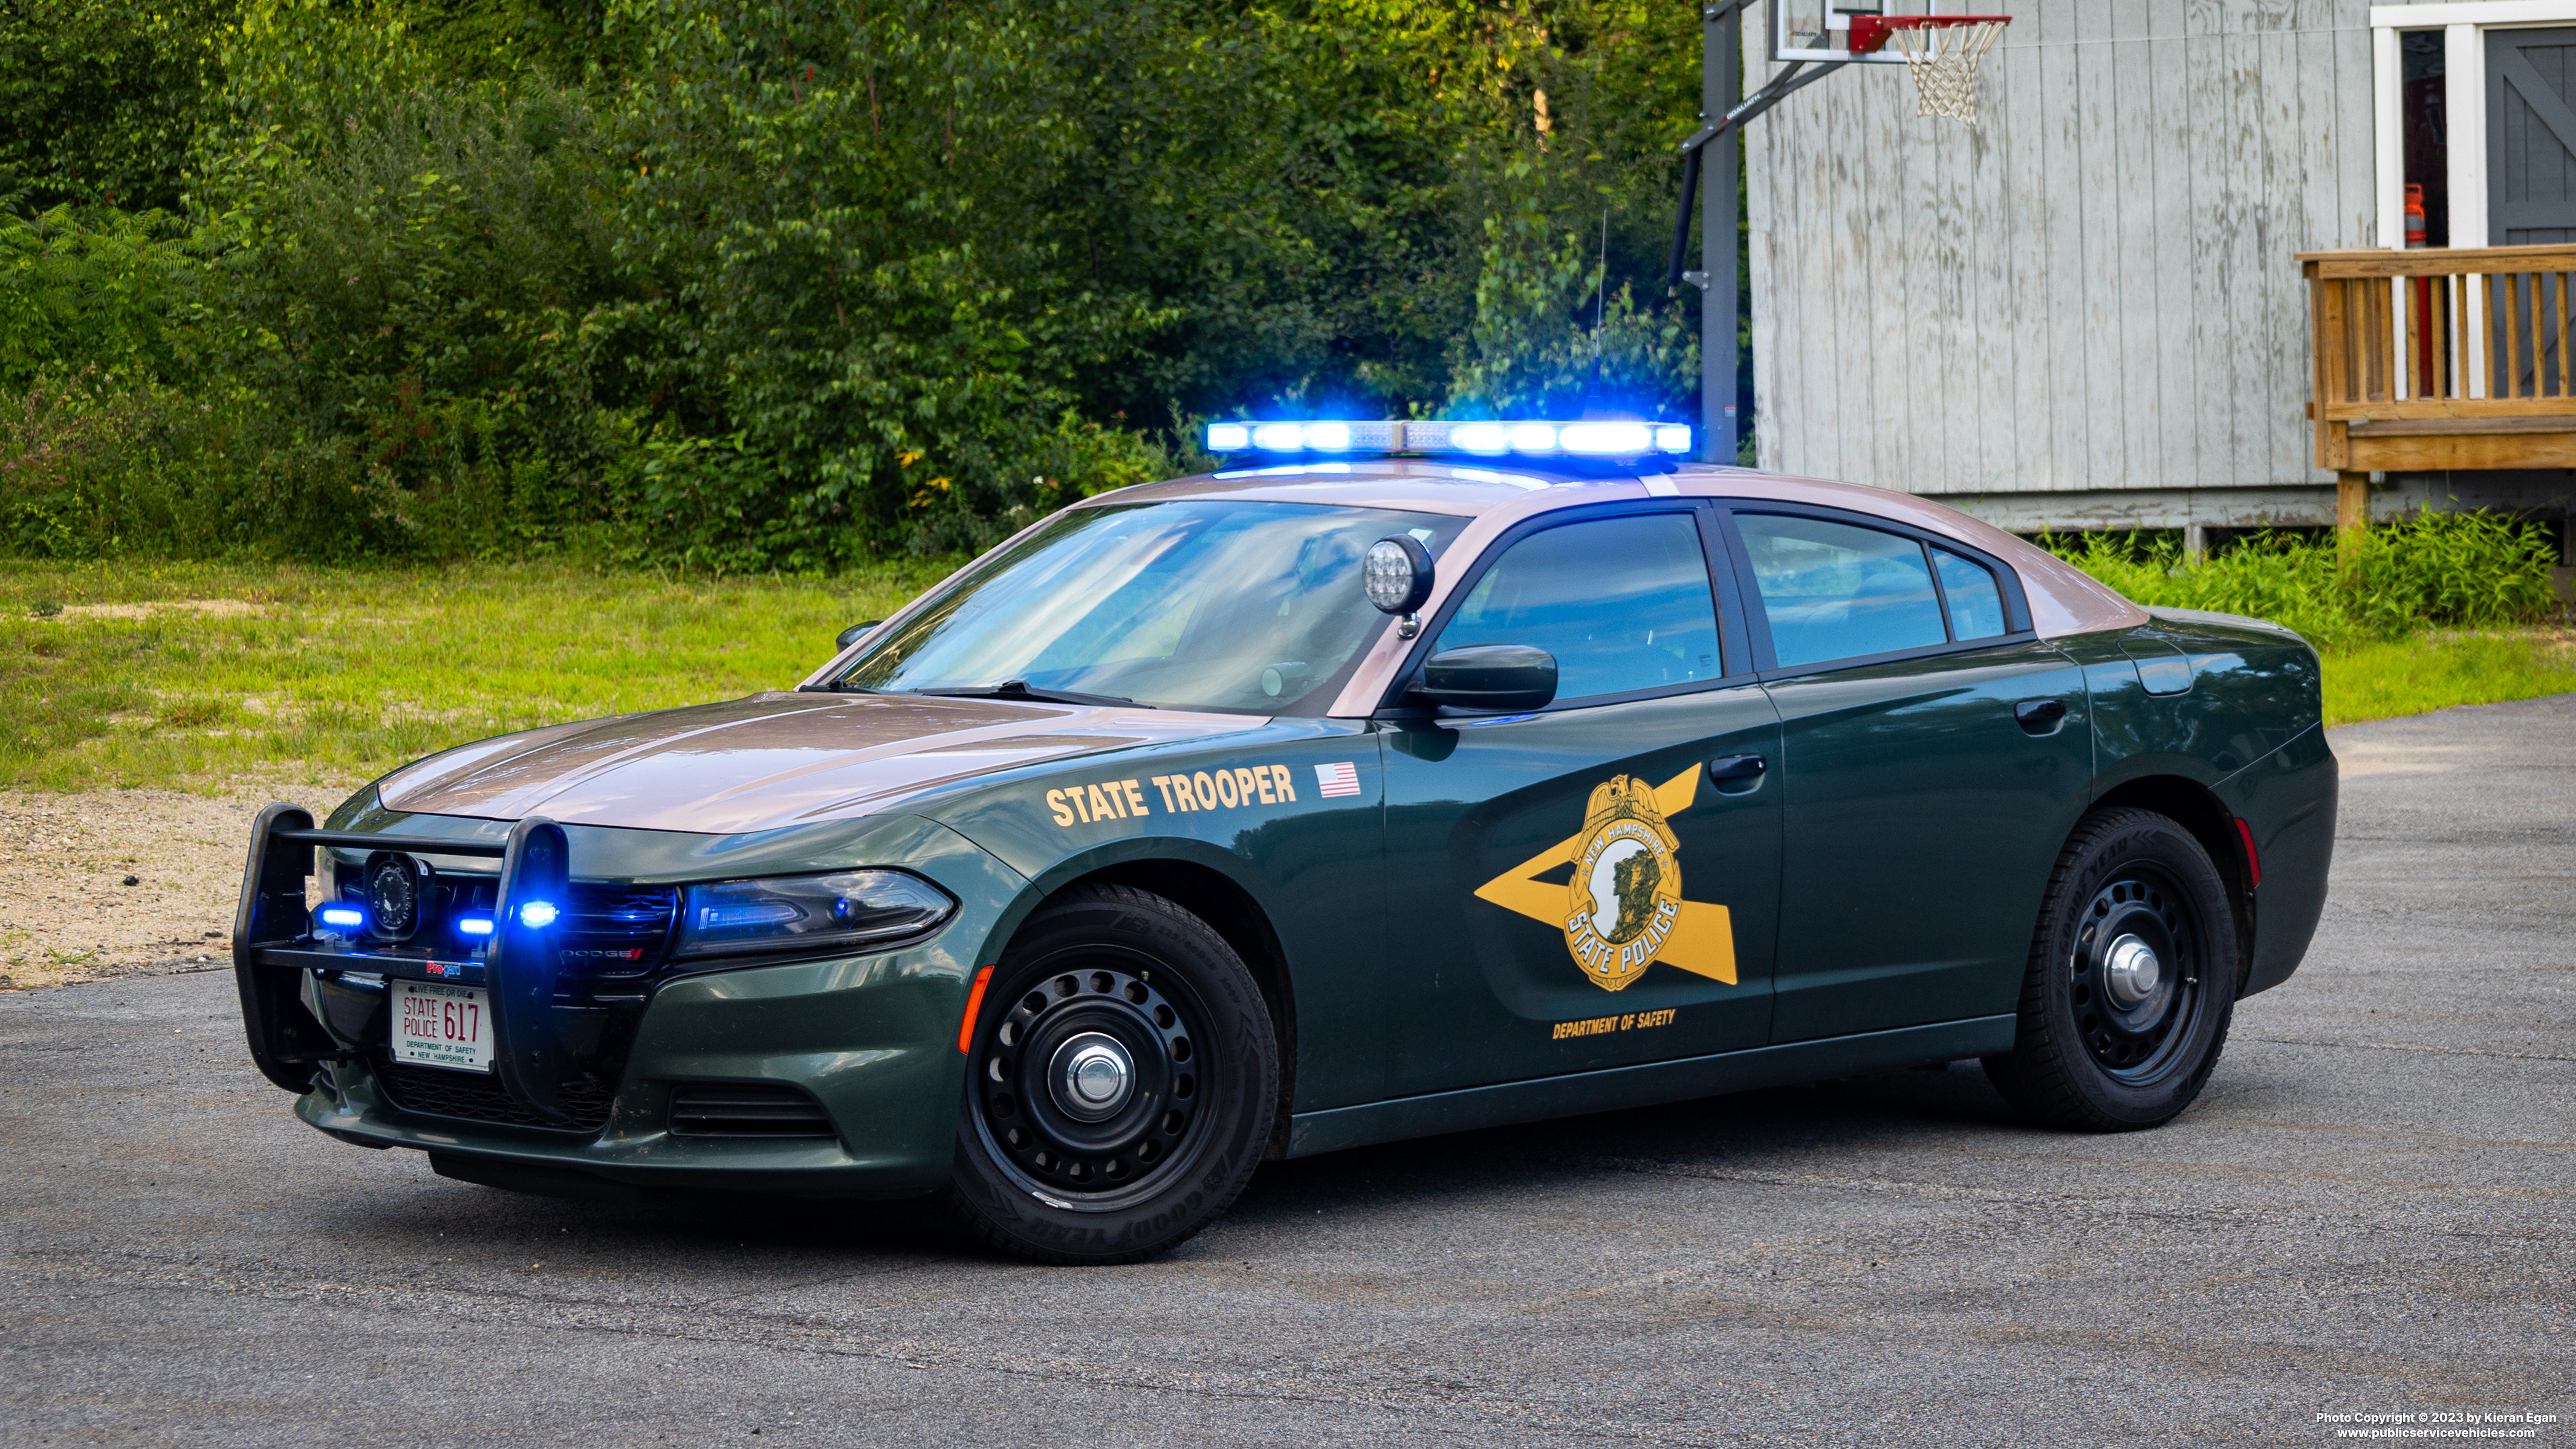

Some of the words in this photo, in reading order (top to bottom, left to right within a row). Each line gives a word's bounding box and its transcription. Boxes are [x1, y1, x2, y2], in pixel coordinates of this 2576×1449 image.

[1726, 93, 1760, 120] GOALIATH
[1045, 779, 1149, 827] STATE
[1151, 764, 1297, 813] TROOPER
[1585, 835, 1604, 866] NEW
[1607, 823, 1666, 858] HAMPSHIRE
[1568, 910, 1614, 973] STATE
[1621, 899, 1679, 973] POLICE
[415, 985, 427, 994] LIVE
[429, 987, 444, 996] FREE
[446, 988, 455, 997] OR
[457, 989, 467, 997] DIE
[404, 997, 437, 1017] STATE
[404, 1017, 438, 1038] POLICE
[444, 1001, 479, 1042] 617
[1552, 1016, 1618, 1039] DEPARTMENT
[1620, 1014, 1635, 1031] OF
[1637, 1008, 1676, 1029] SAFETY
[406, 1040, 442, 1051] DEPARTMENT
[455, 1046, 476, 1055] SAFETY
[434, 1052, 465, 1063] HAMPSHIRE
